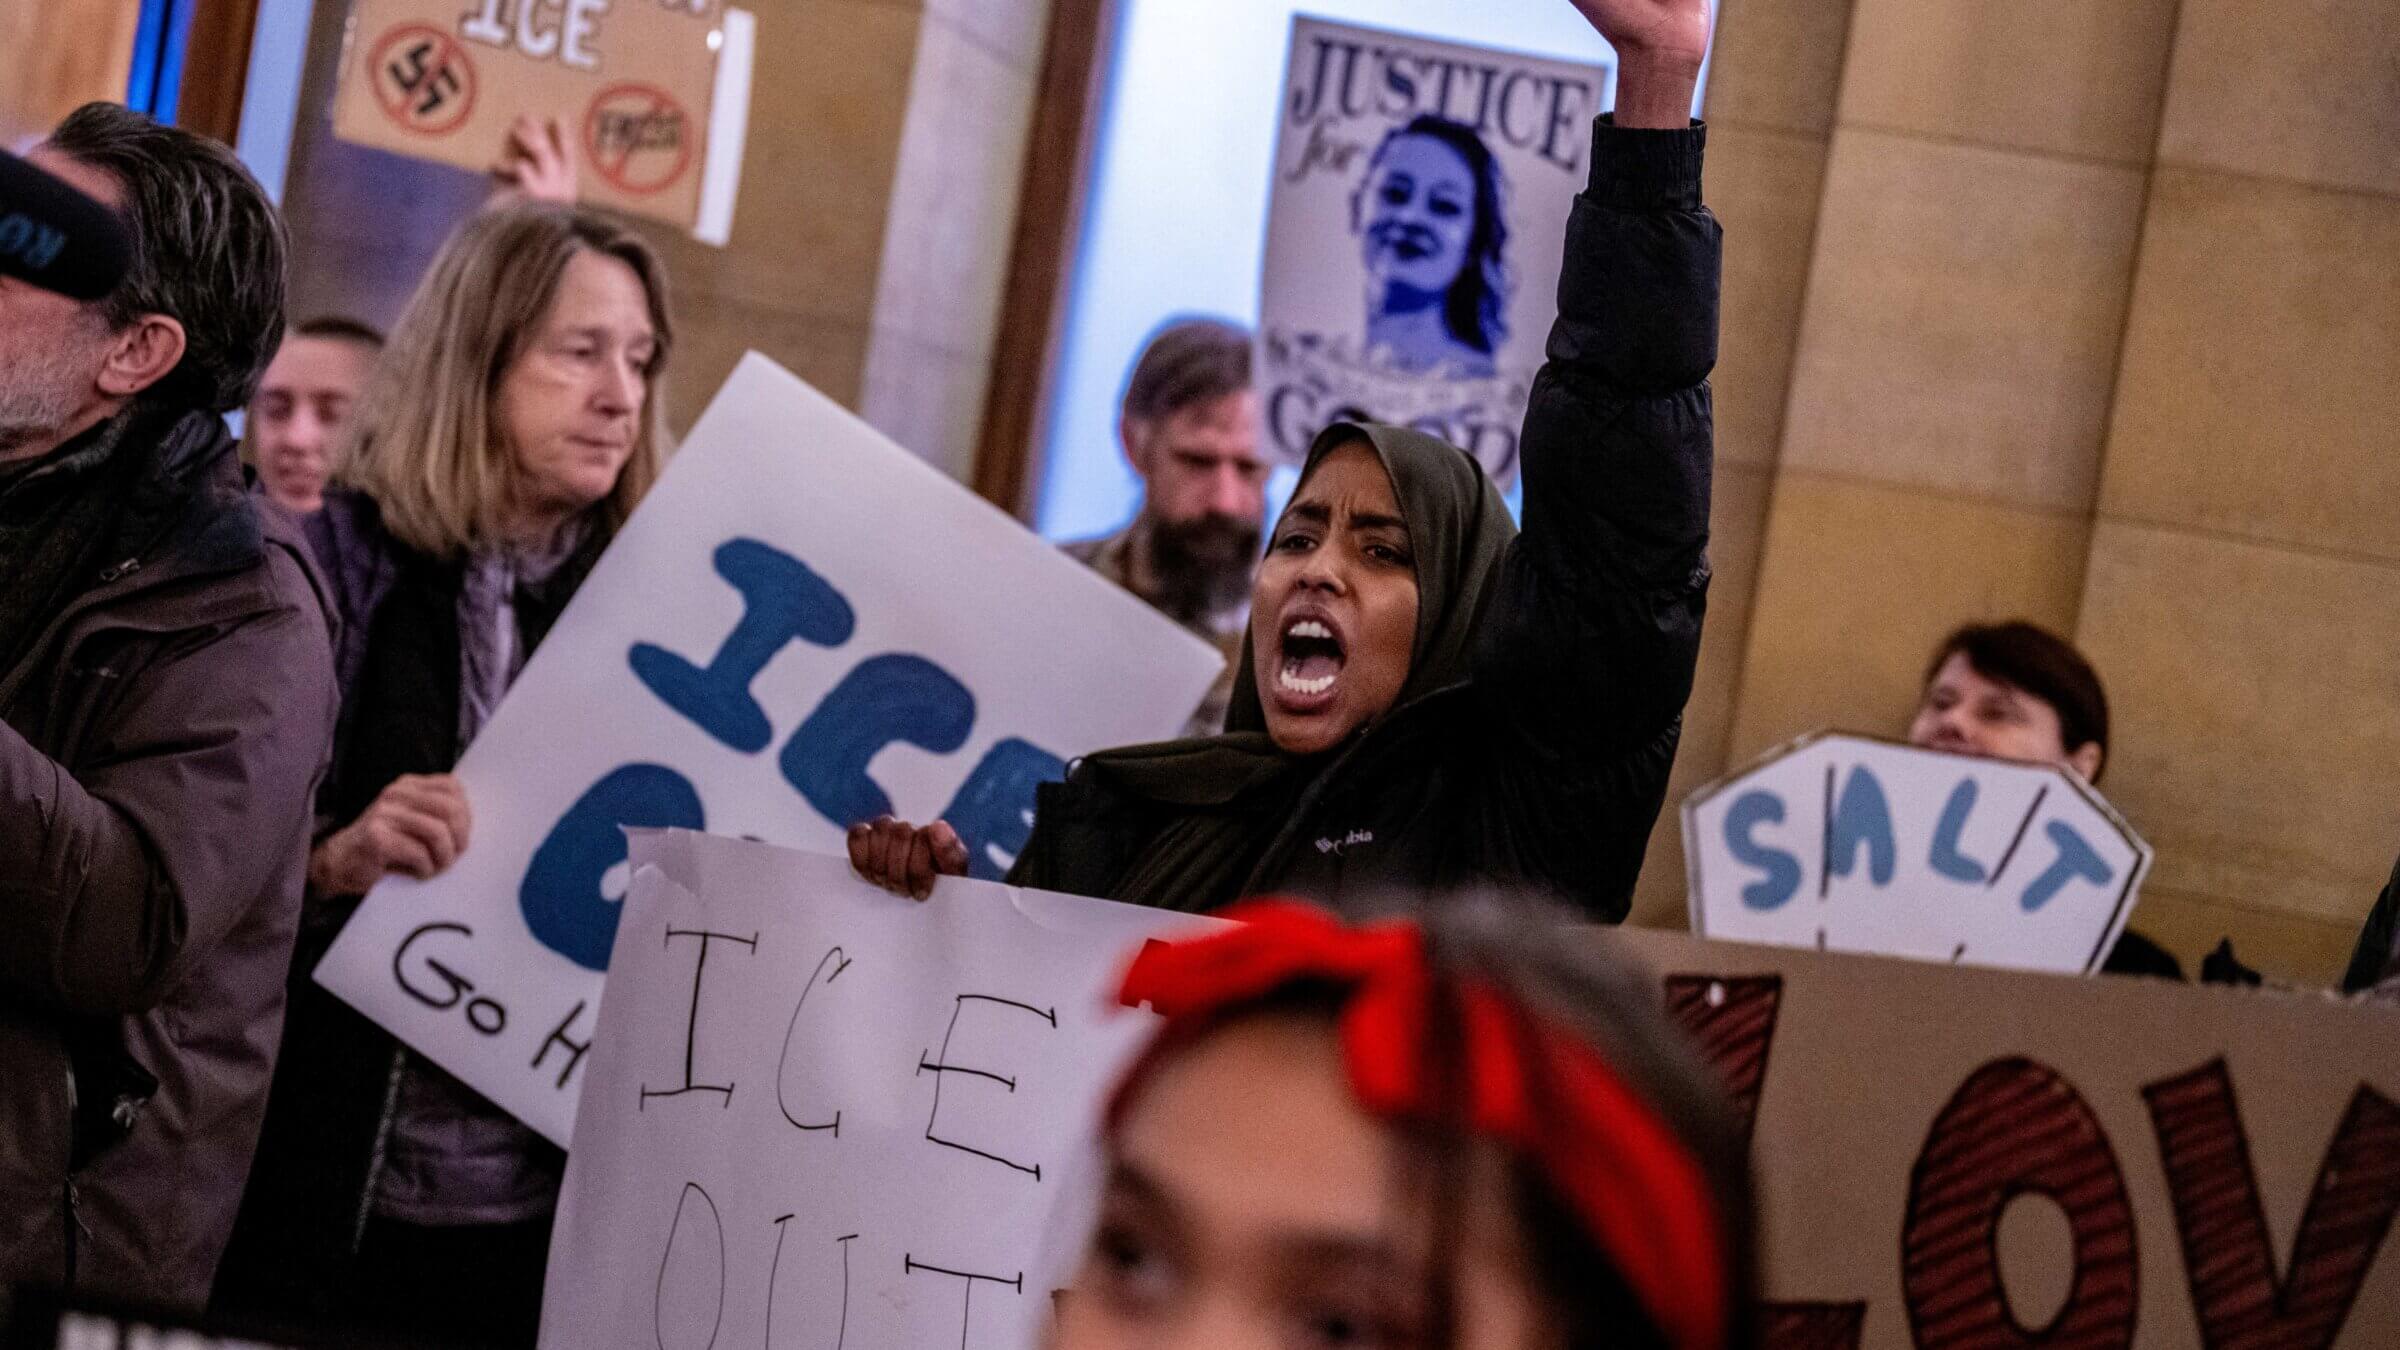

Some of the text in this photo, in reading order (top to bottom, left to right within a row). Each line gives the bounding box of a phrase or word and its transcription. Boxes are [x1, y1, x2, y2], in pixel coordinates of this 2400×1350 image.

[458, 0, 602, 70] ICE
[1290, 35, 1591, 173] JUSTICE
[1284, 118, 1361, 183] for
[627, 536, 1068, 884] ICE
[1722, 764, 2114, 912] SALT
[393, 921, 507, 1037] Go
[640, 922, 1057, 1182] ICE
[655, 1182, 1022, 1350] OUT
